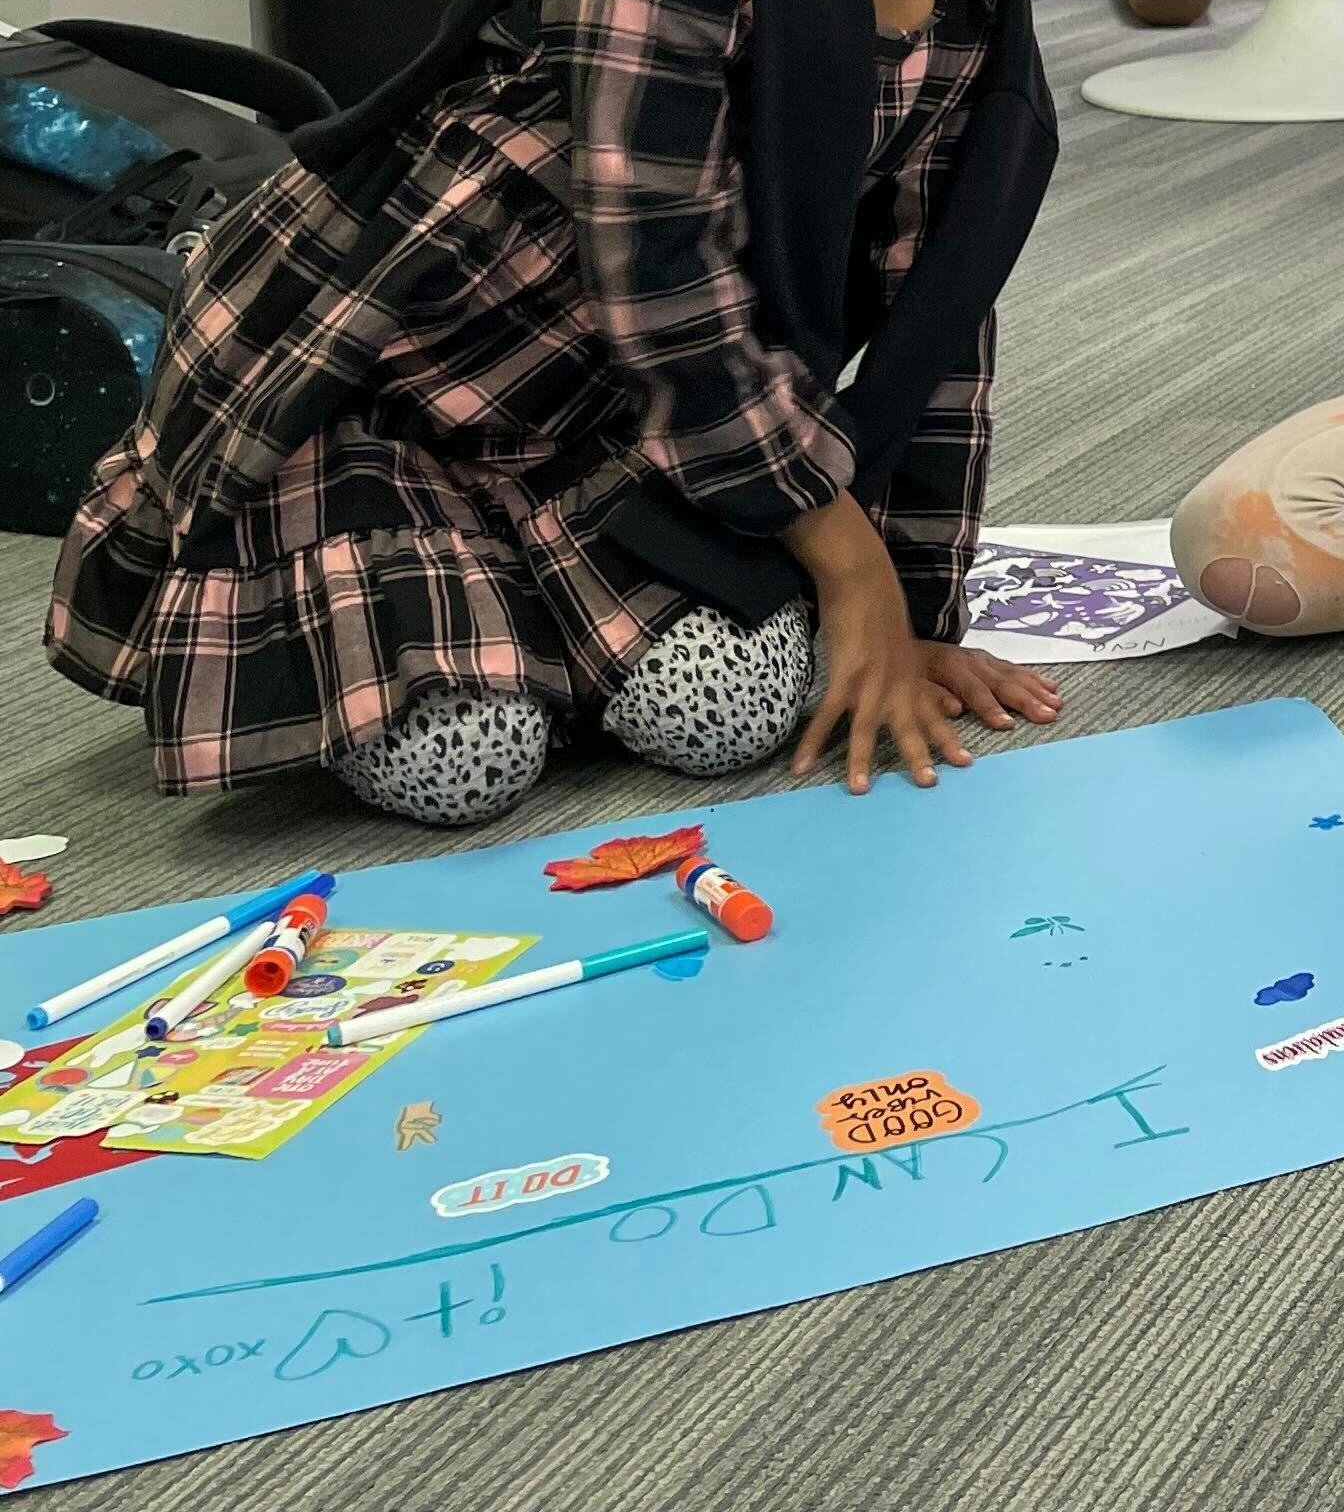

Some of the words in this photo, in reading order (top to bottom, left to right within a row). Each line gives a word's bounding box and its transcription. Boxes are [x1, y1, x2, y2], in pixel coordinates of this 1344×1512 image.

[847, 1100, 963, 1144] GOOD
[462, 1177, 509, 1209] IT
[522, 1162, 584, 1194] DO
[608, 1184, 778, 1244] DO
